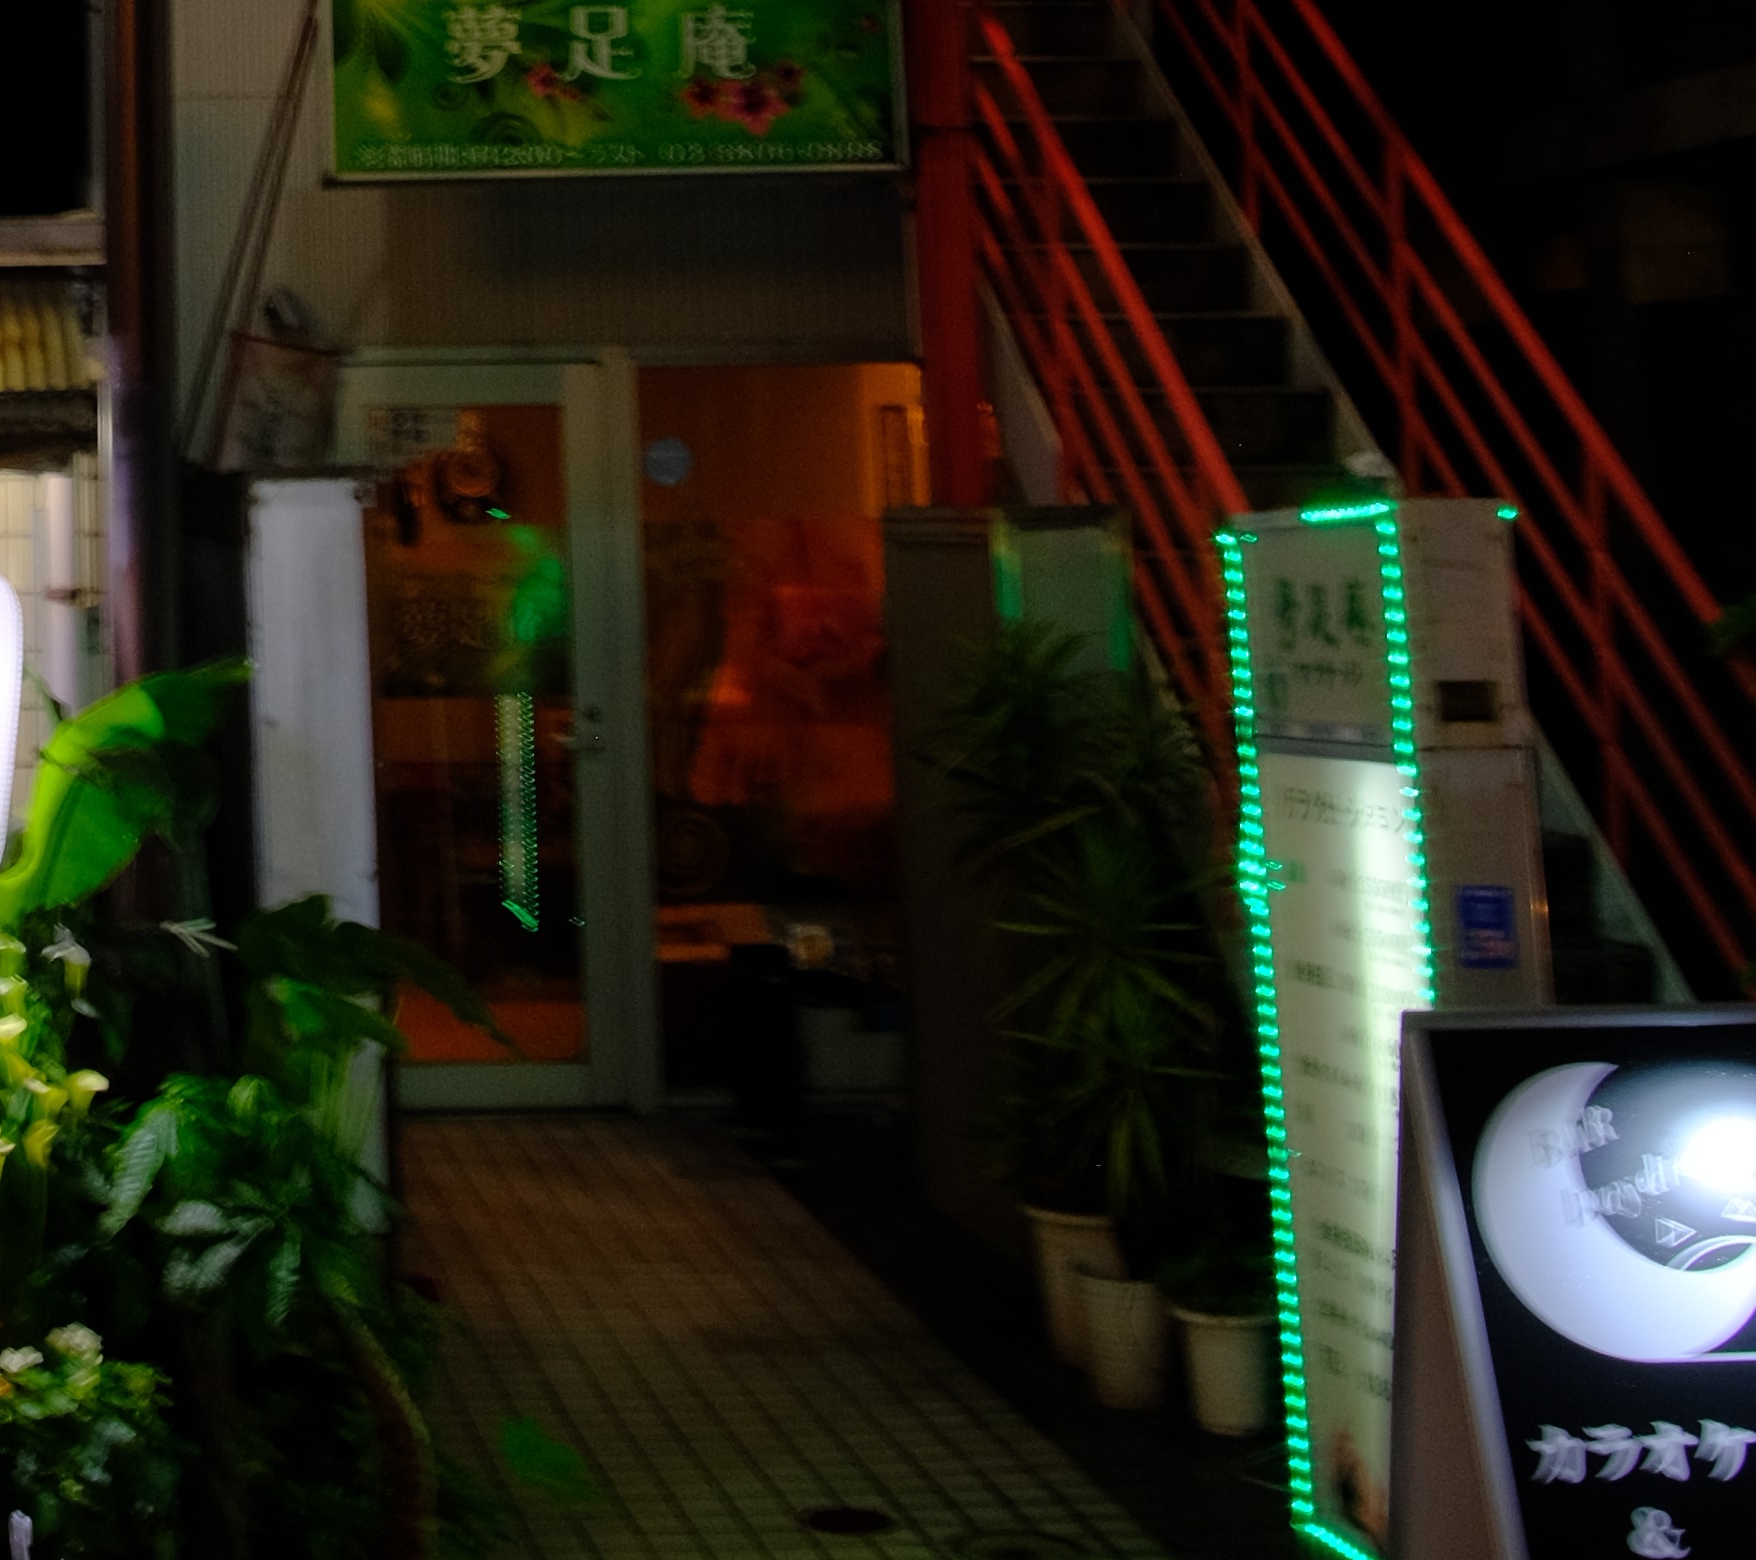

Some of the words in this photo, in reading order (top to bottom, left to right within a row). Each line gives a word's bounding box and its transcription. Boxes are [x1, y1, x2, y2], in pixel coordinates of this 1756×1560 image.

[444, 2, 758, 84] 夢足庵
[1526, 1420, 1756, 1484] カラオケ
[1627, 1506, 1692, 1560] &
